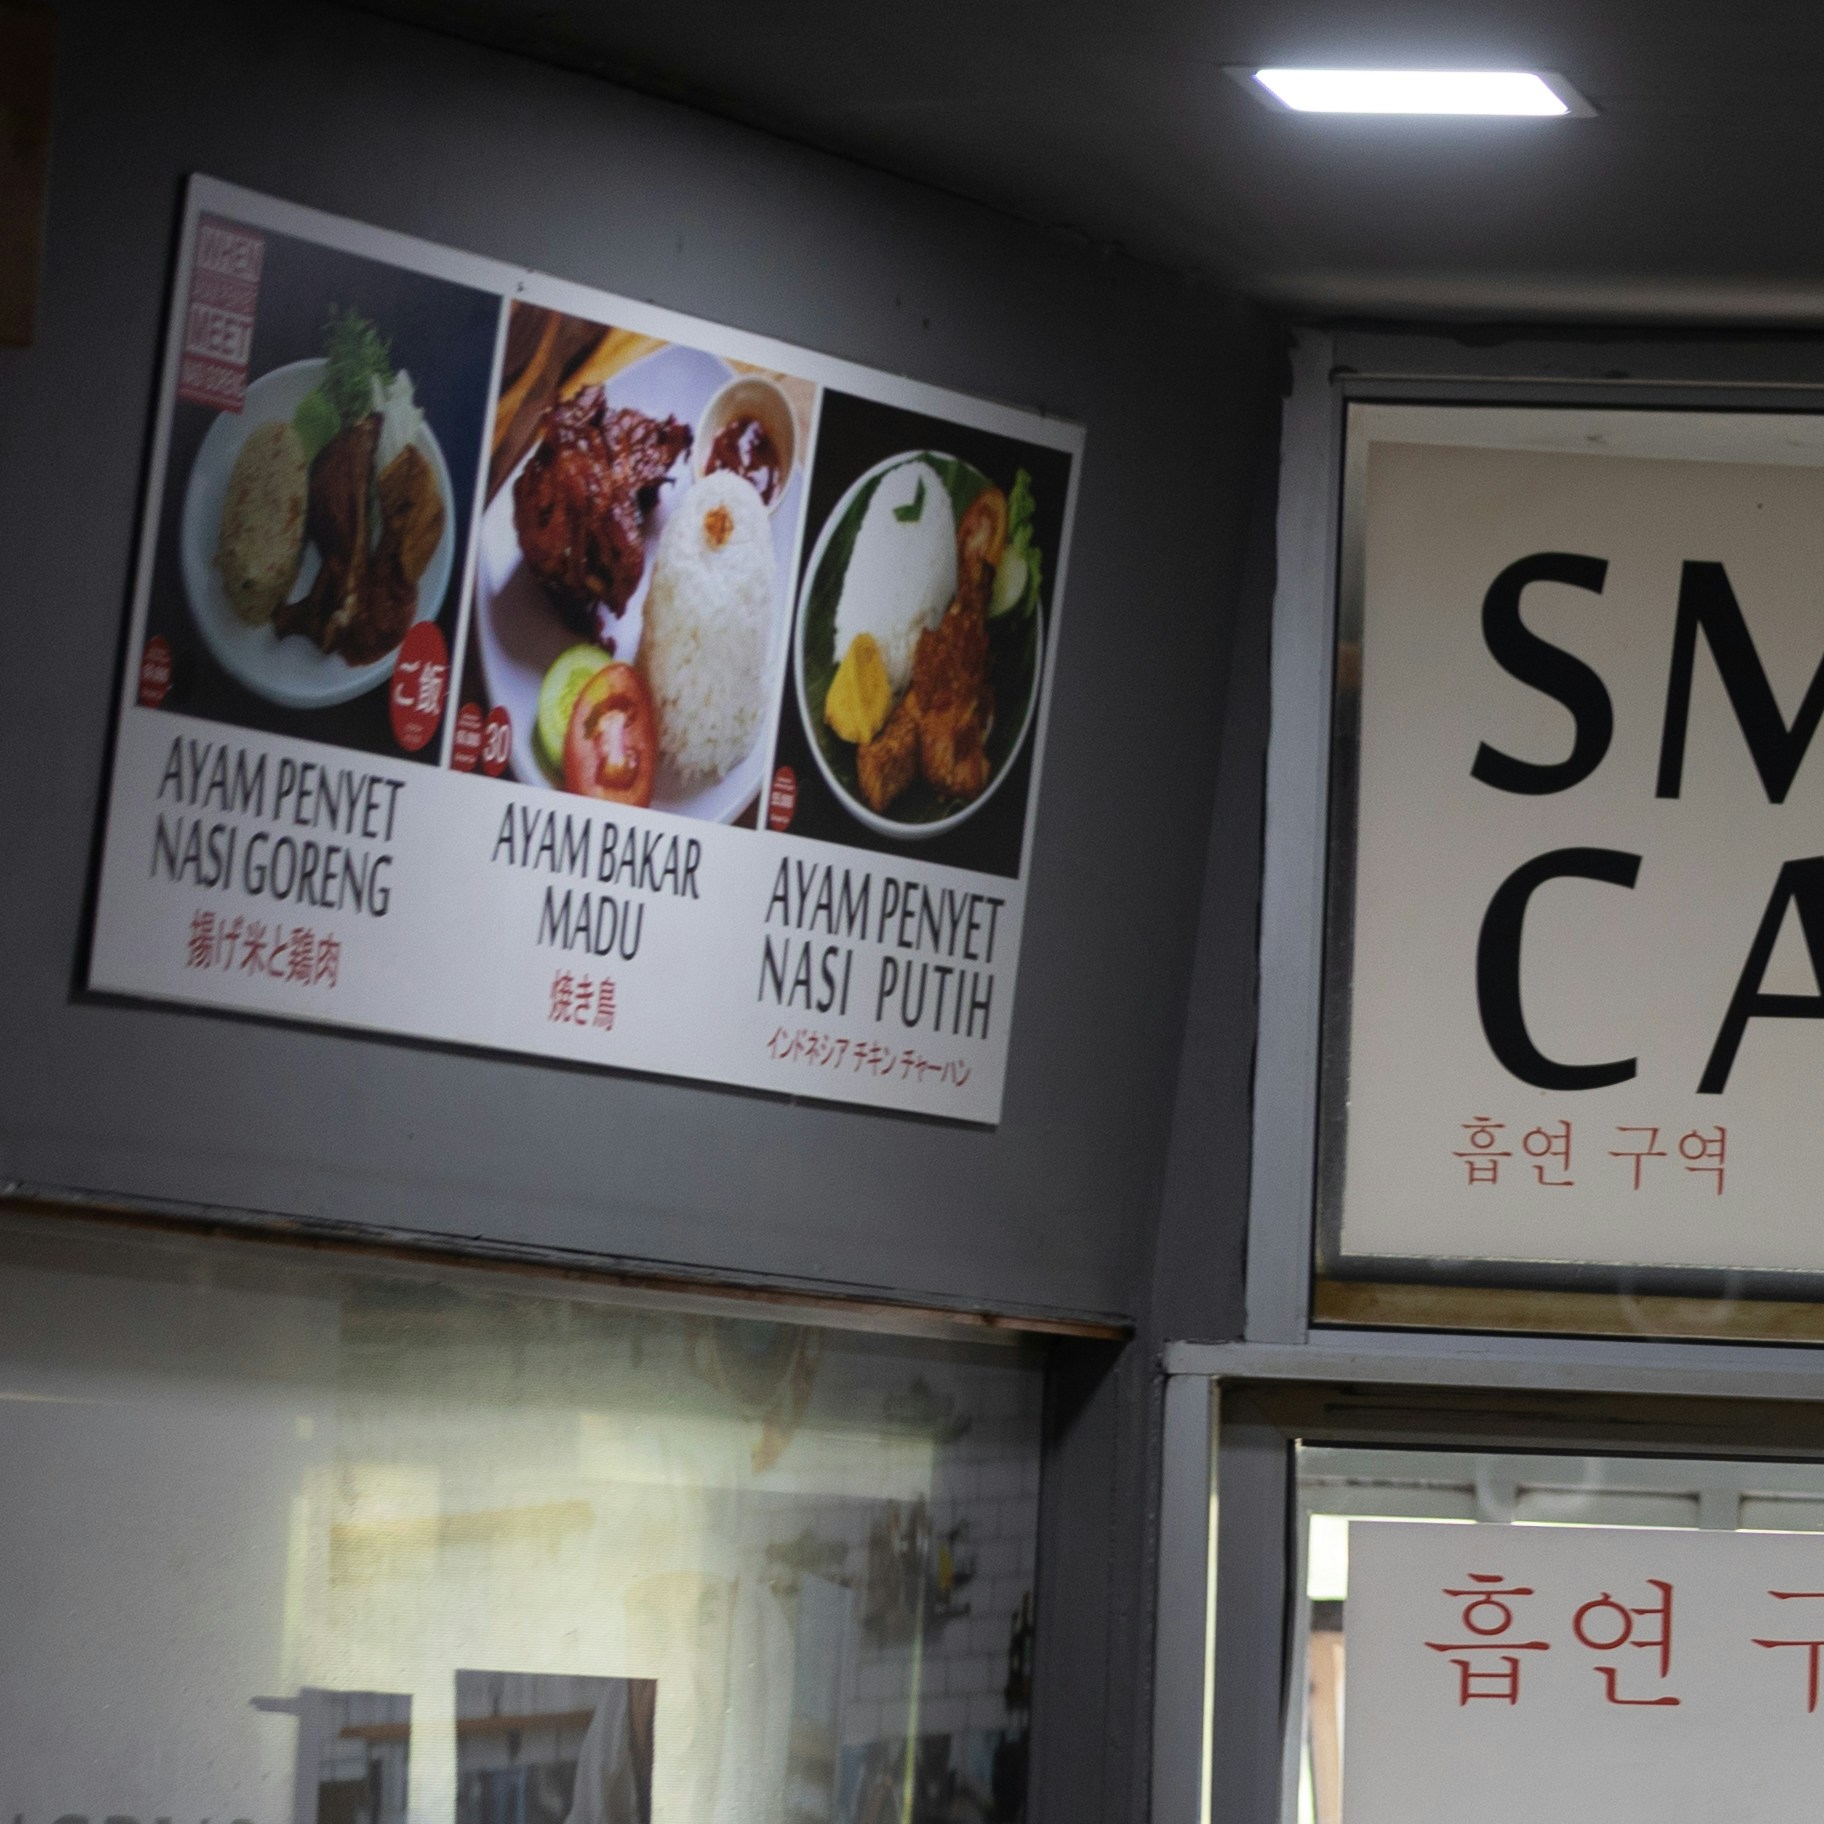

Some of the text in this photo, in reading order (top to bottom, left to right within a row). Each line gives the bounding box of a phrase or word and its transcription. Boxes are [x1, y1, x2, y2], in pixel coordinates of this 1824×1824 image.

[157, 734, 406, 842] AYAM PENYET
[152, 812, 393, 918] NASI GORENG
[490, 802, 702, 900] AYAM BAKAR
[537, 885, 645, 961] MADU
[764, 855, 1006, 964] AYAM PENYET
[757, 933, 994, 1040] NASI PUTIH
[1453, 1116, 1727, 1196] 흡연 구역
[1424, 1572, 1681, 1707] 흡연
